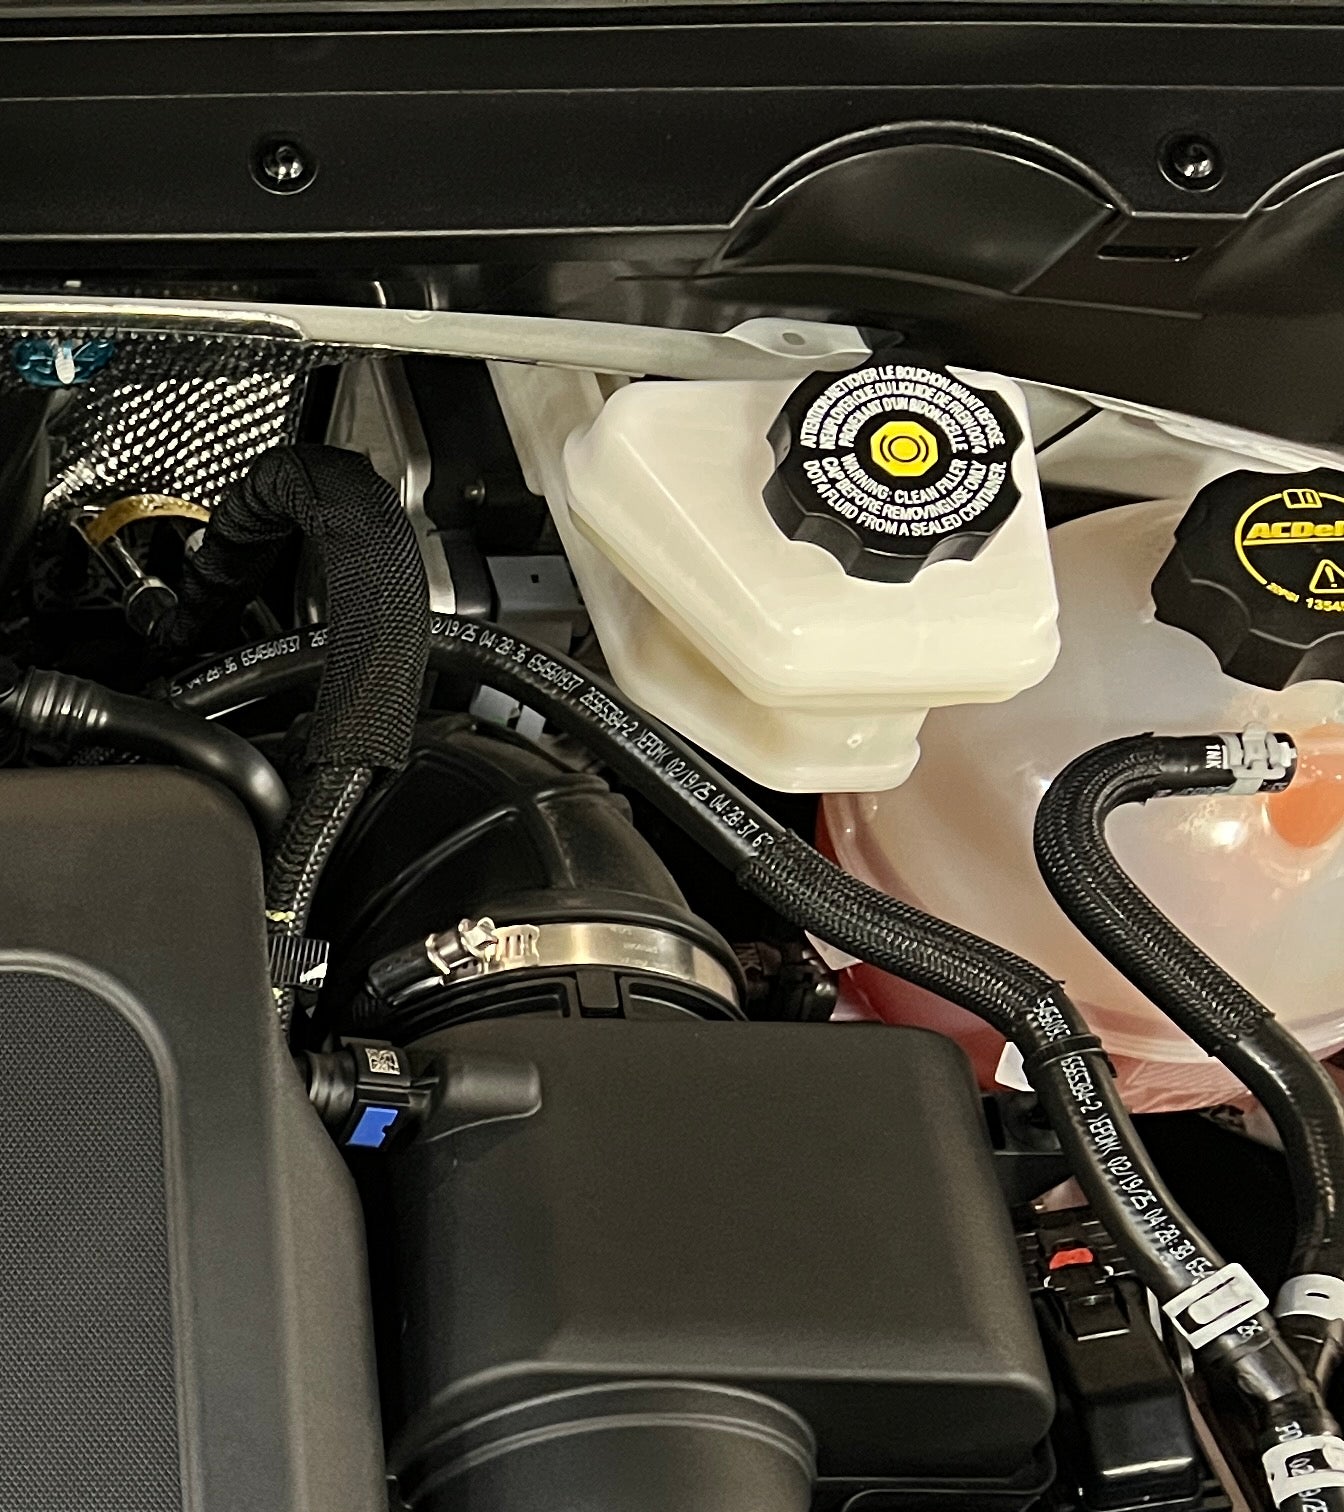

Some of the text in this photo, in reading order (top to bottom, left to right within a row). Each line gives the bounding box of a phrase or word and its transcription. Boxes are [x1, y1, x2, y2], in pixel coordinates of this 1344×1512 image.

[878, 365, 895, 380] LE
[895, 365, 951, 390] BOUCHON
[946, 382, 985, 411] AVANT
[909, 398, 944, 425] BIDON
[933, 390, 953, 409] DE
[945, 400, 978, 430] FREIN
[822, 456, 846, 480] CAP
[835, 478, 884, 515] BEFORE
[963, 460, 987, 491] ONLY
[840, 453, 968, 505] WARNING: CLEAN FILLER
[821, 488, 859, 519] FLUID
[856, 511, 898, 535] FROM
[899, 522, 910, 536] A
[910, 513, 963, 536] SEALED
[430, 616, 481, 642] 2/19/25
[666, 757, 717, 801] 02/19/25
[1107, 1156, 1158, 1210] 02/19/25
